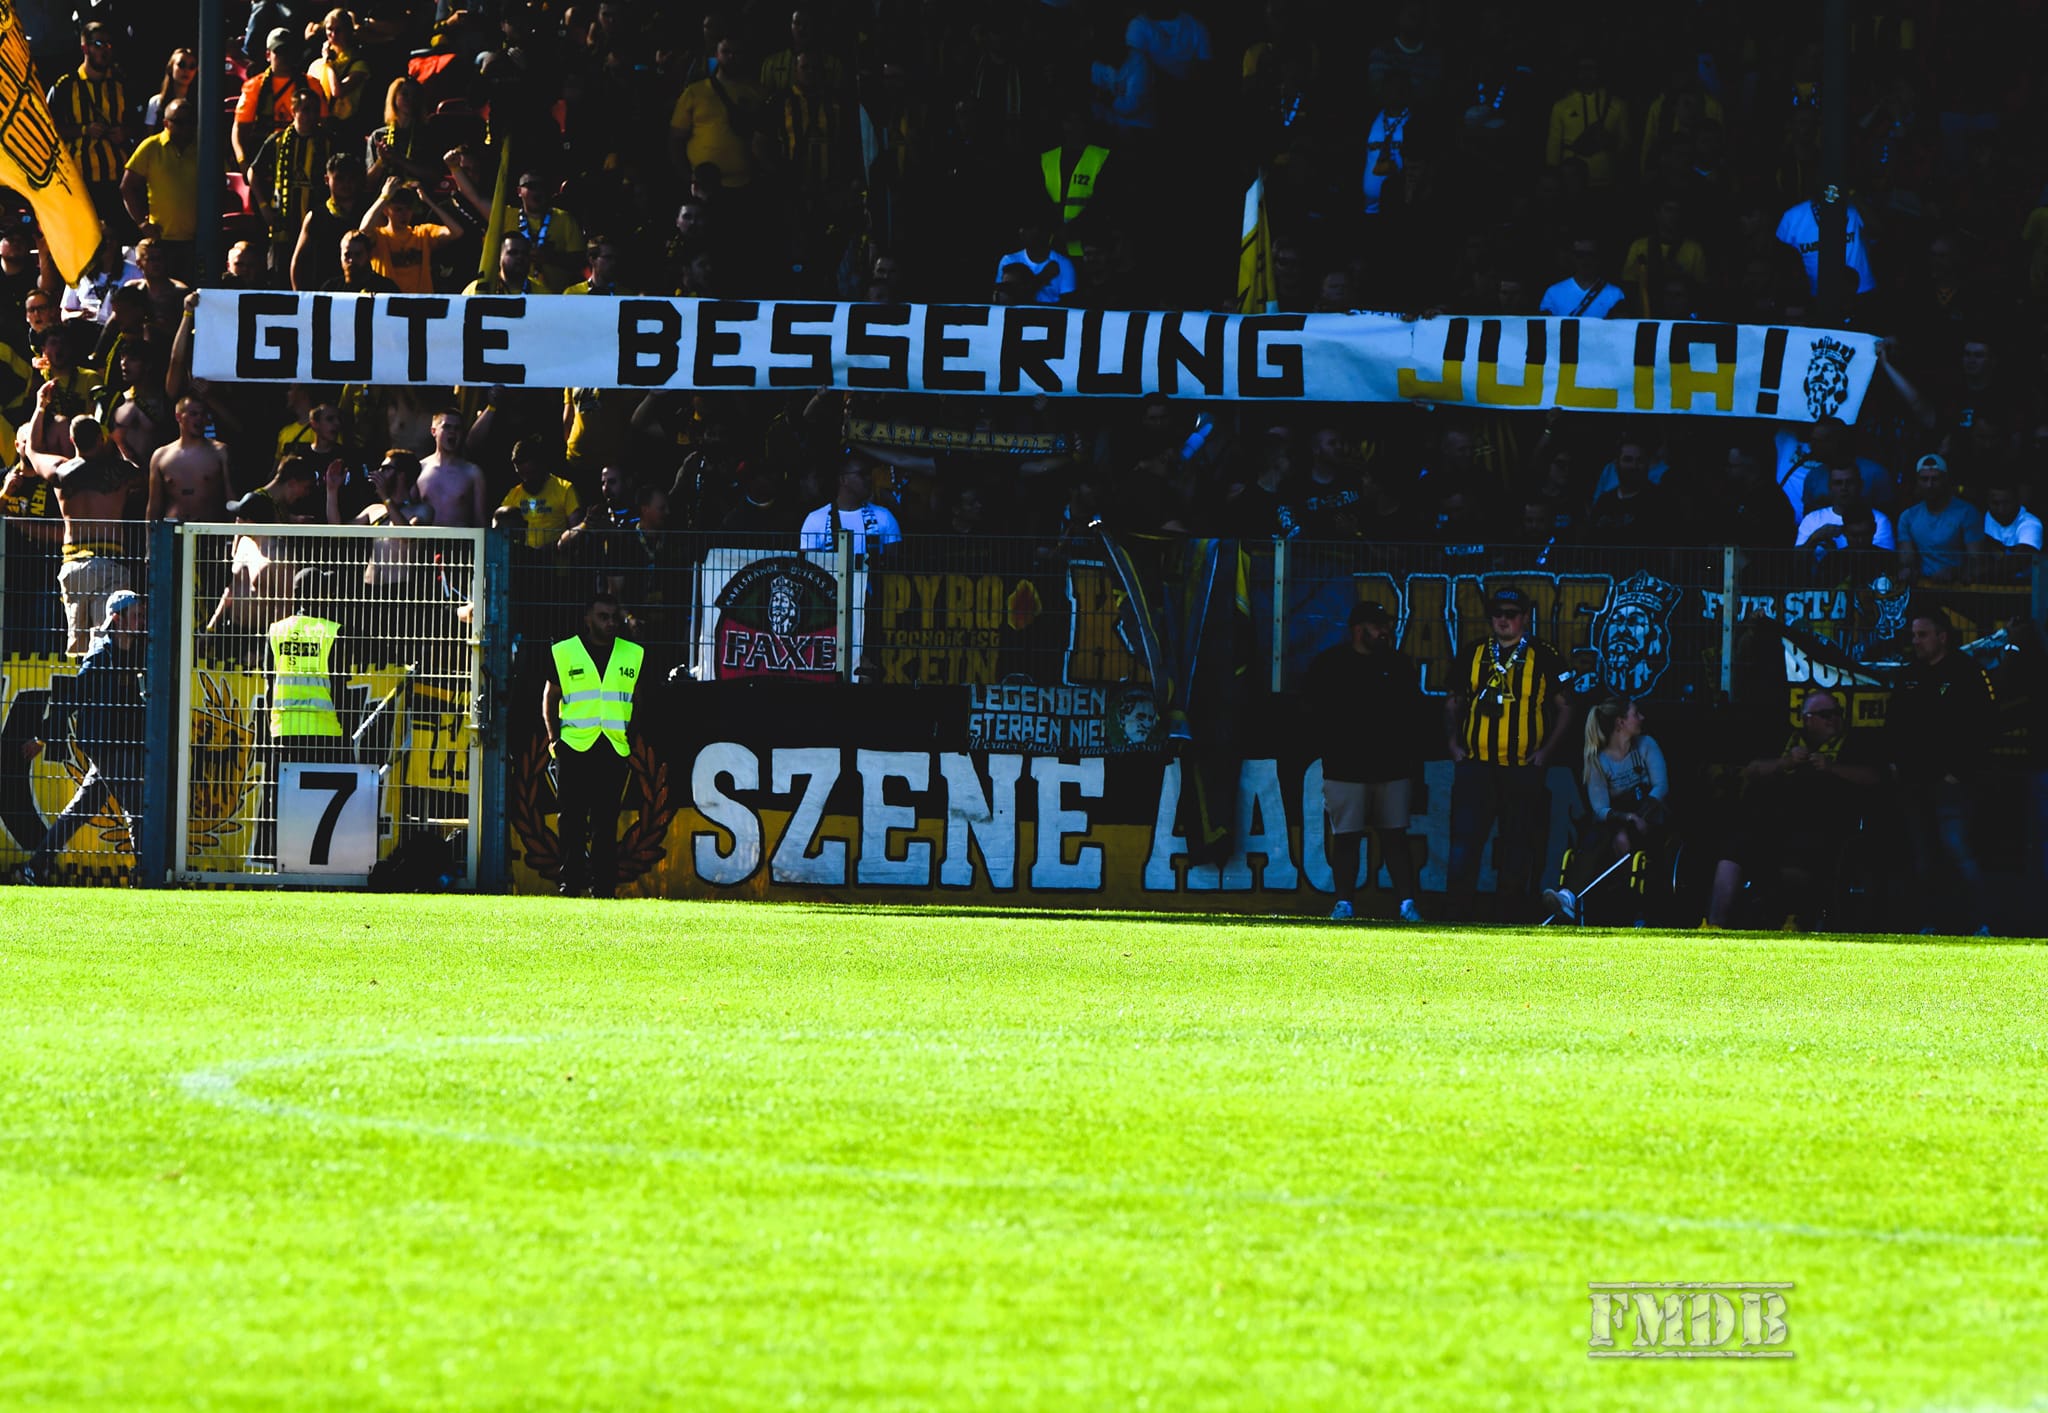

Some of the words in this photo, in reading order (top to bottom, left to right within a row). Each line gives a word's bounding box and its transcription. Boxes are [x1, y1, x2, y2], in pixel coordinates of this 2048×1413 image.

[236, 293, 527, 384] GUTE
[617, 297, 1306, 398] BESSERUNG
[1397, 317, 1789, 415] JULIA!
[881, 573, 1005, 630] PYRO
[722, 629, 837, 671] FAXE
[880, 648, 1000, 686] KEIN
[618, 666, 635, 679] 148
[969, 682, 1107, 717] LEGENDEN
[968, 712, 1063, 750] STERBEN
[1069, 718, 1105, 749] NIE!
[299, 771, 358, 866] 7
[691, 740, 1106, 891] SZENE
